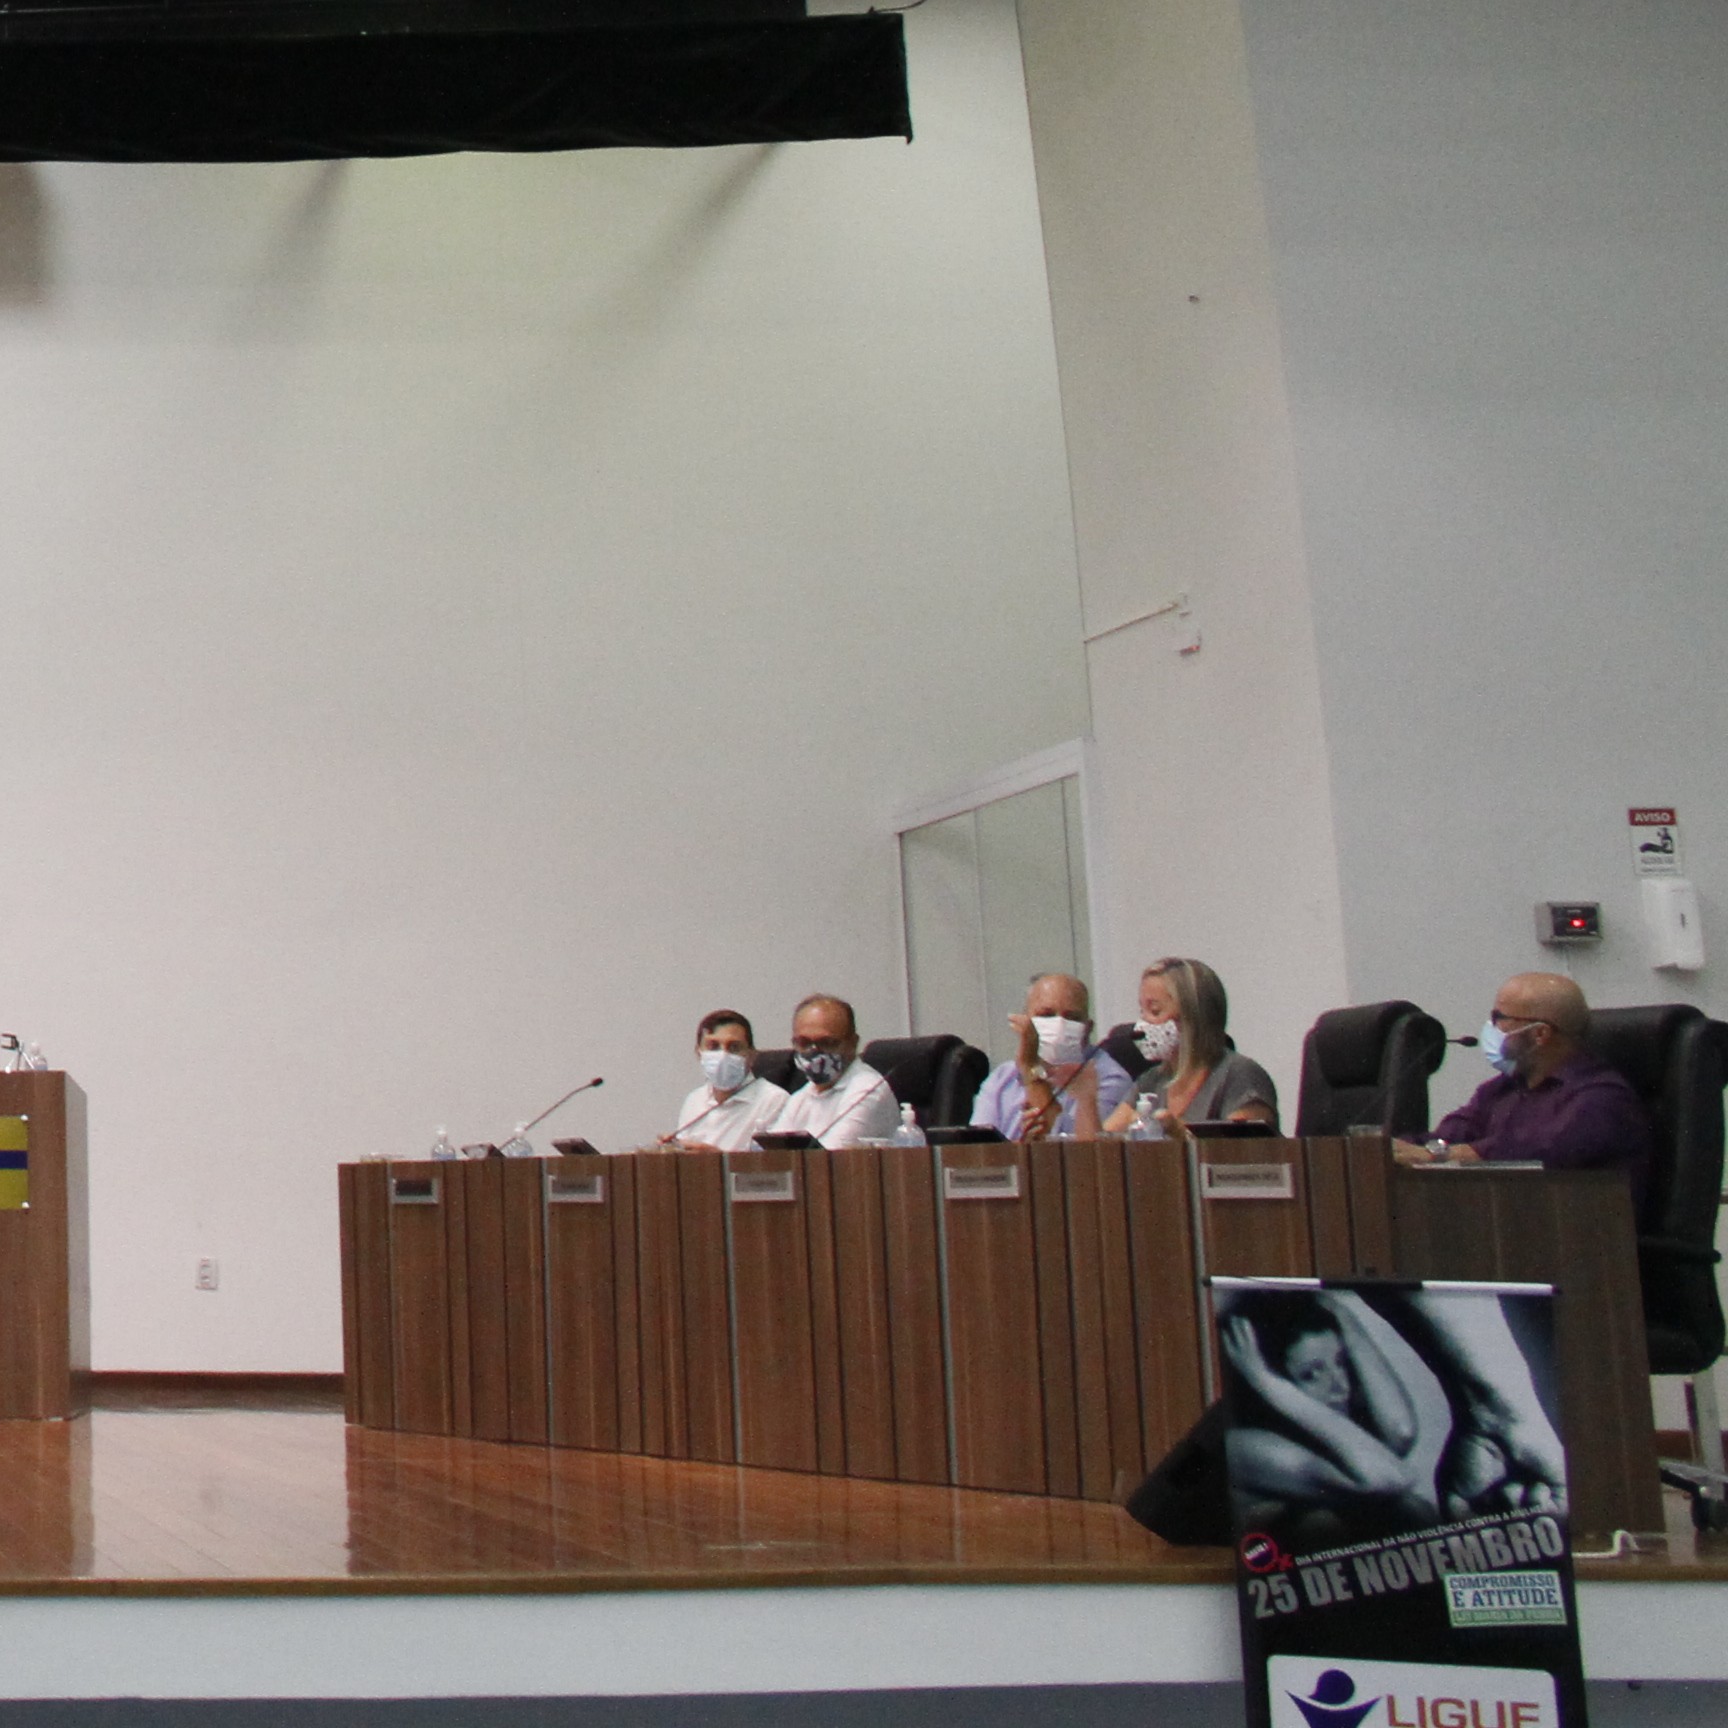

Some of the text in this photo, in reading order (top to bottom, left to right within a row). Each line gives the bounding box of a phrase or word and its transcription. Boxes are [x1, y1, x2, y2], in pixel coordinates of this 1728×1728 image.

[1634, 812, 1671, 822] AVISO
[1247, 1515, 1563, 1619] 25 DE NOVEMBRO
[1450, 1574, 1555, 1589] COMPROMISSO
[1453, 1588, 1558, 1608] E ATITUDE
